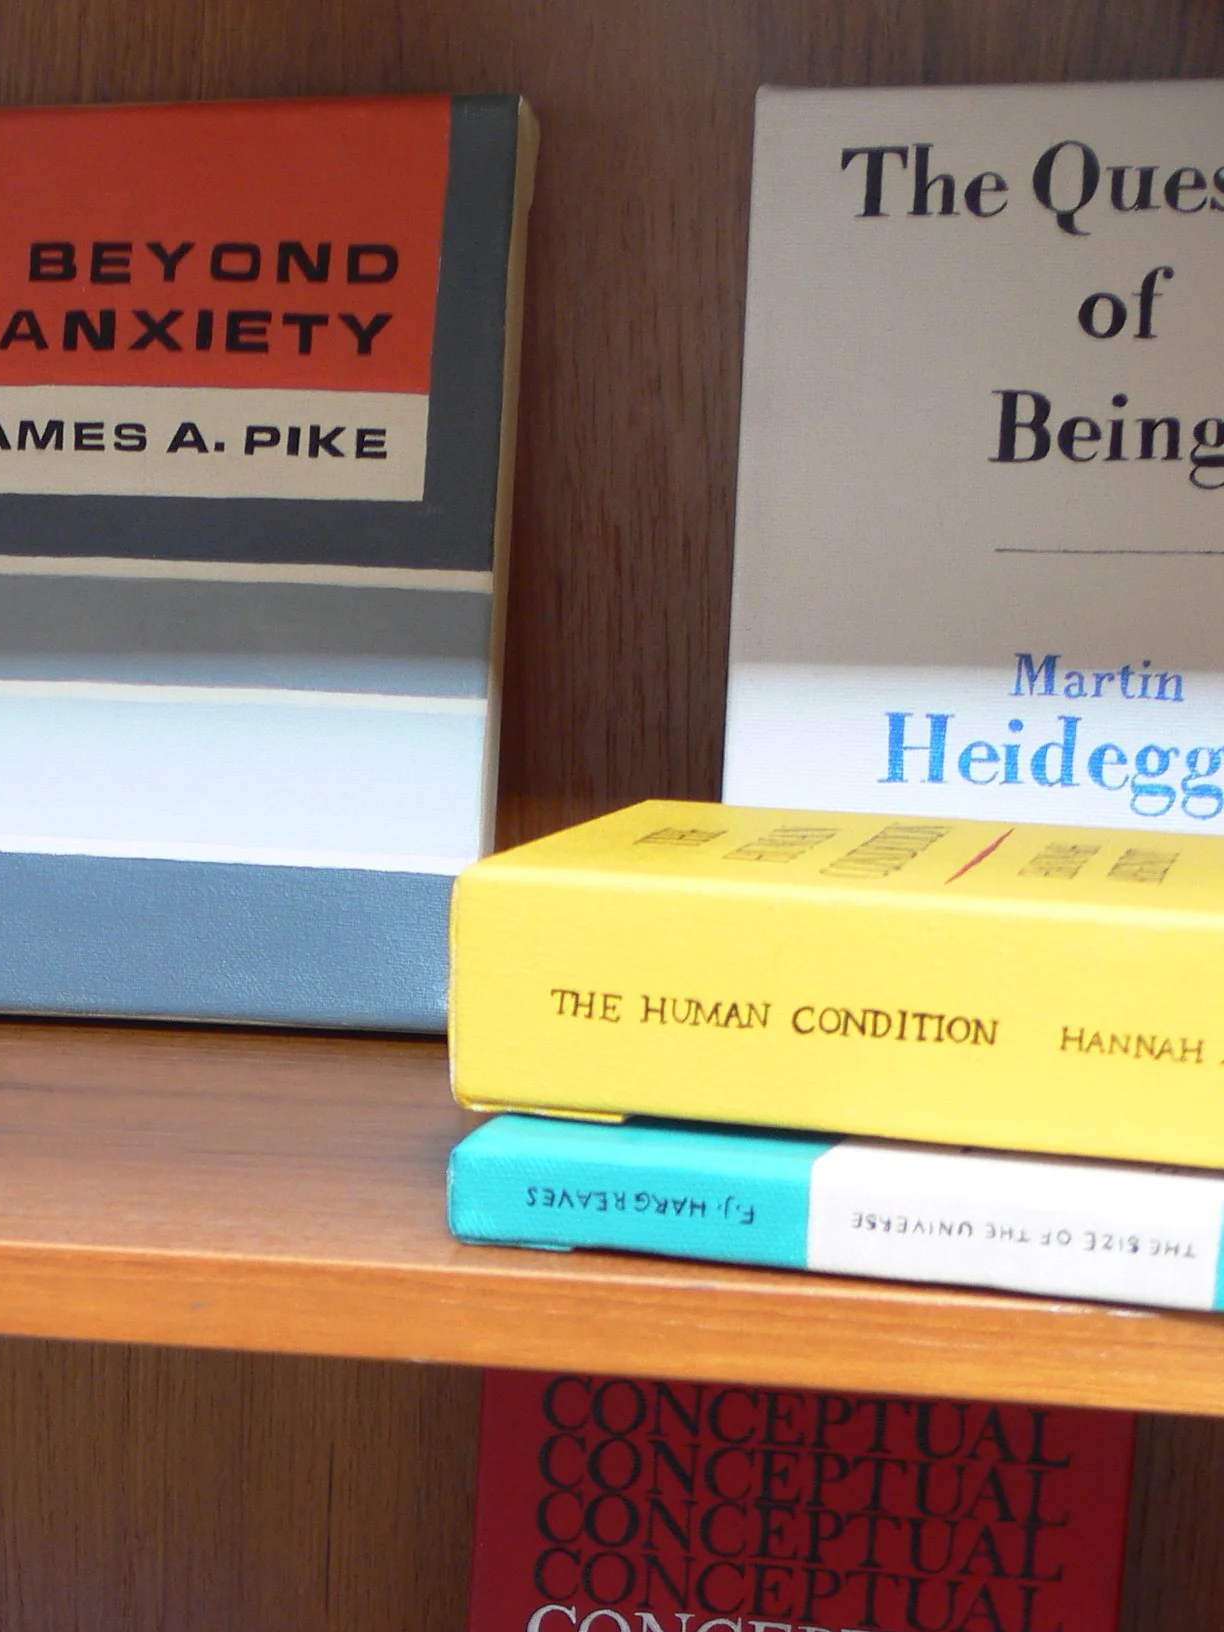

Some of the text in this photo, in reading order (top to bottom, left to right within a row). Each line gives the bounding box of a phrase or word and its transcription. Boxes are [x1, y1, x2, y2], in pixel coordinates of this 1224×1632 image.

[840, 143, 1007, 218] The
[28, 242, 399, 285] BEYOND
[1078, 266, 1174, 340] of
[166, 422, 225, 454] A.
[243, 425, 387, 459] PIKE
[1009, 652, 1185, 703] Martin
[550, 988, 1204, 1064] THE HUMAN CONDITION HANNAH
[851, 1212, 1196, 1259] THE SIZE OF THE UNIVERSE
[542, 1375, 1072, 1468] CONCEPTUAL
[538, 1432, 1070, 1527] CONCEPTUAL
[535, 1489, 1065, 1582] CONCEPTUAL
